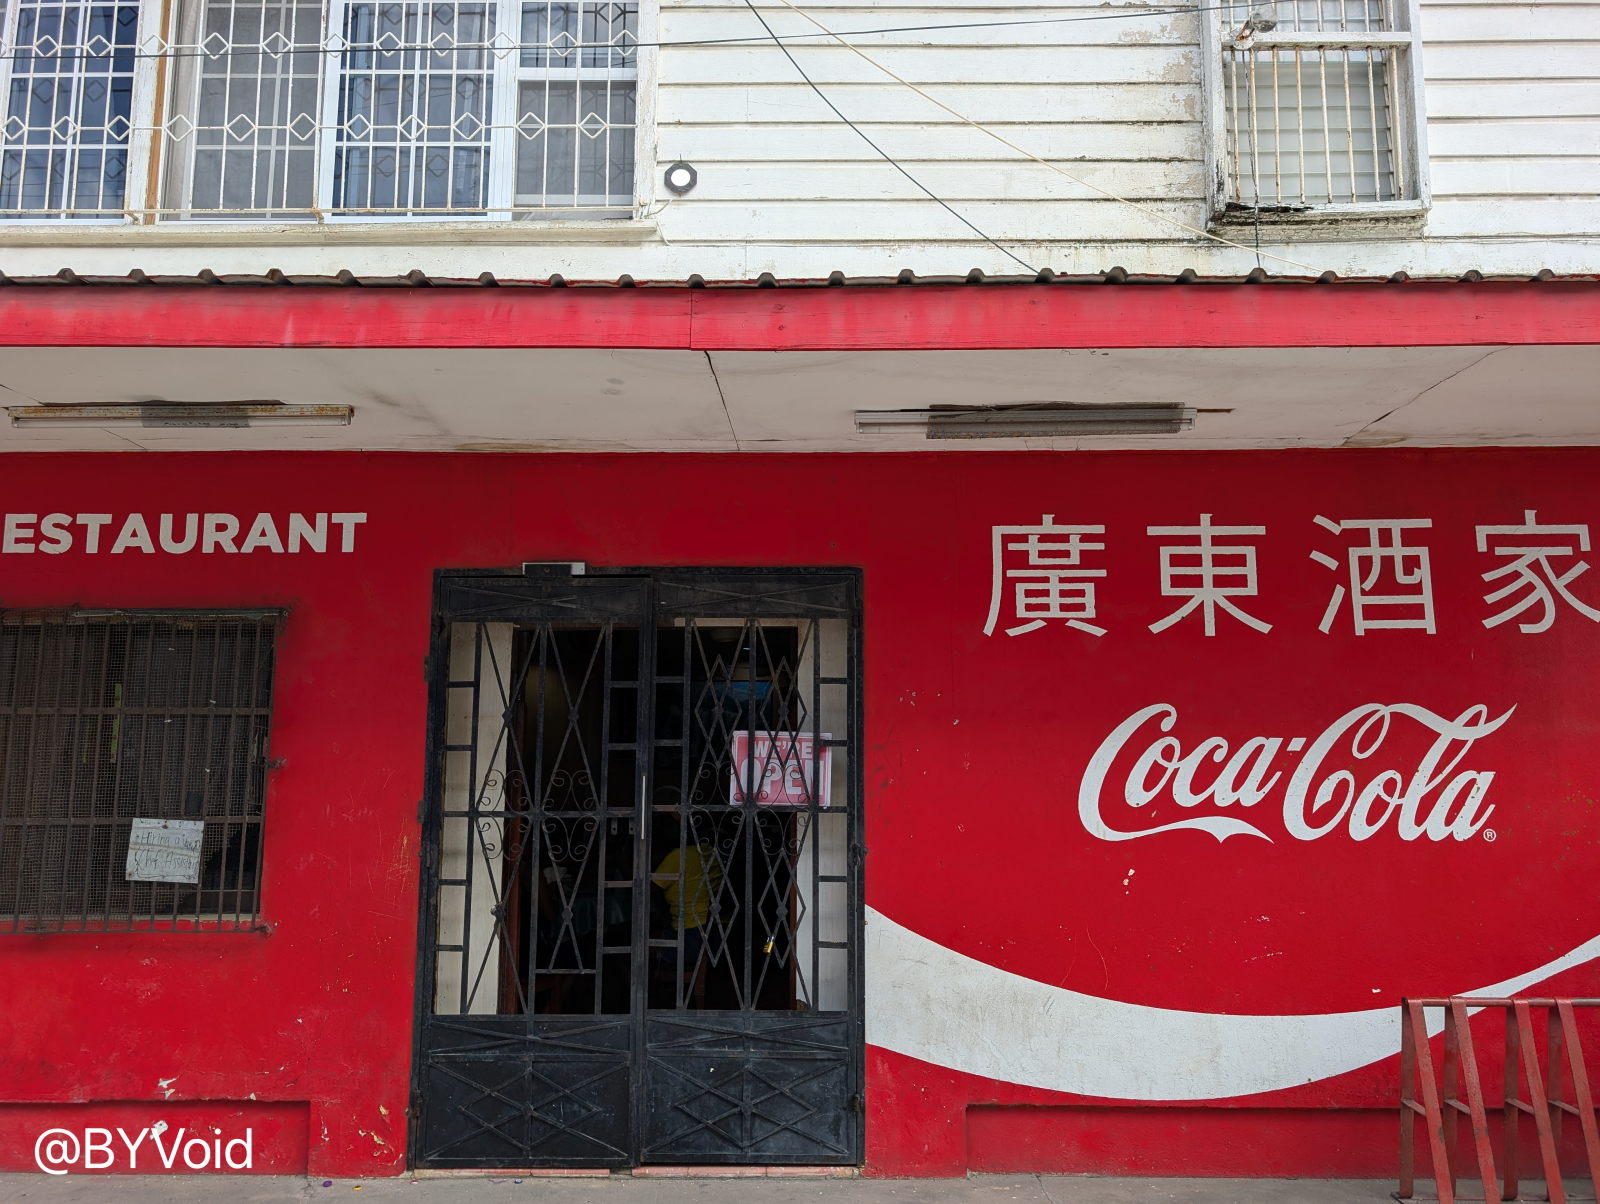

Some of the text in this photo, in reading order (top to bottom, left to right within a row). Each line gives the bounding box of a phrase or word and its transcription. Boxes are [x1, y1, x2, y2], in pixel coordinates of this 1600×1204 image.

[2, 512, 367, 554] ESTAURANT
[982, 509, 1600, 637] 廣東酒家
[1078, 702, 1518, 844] Coca-Cola
